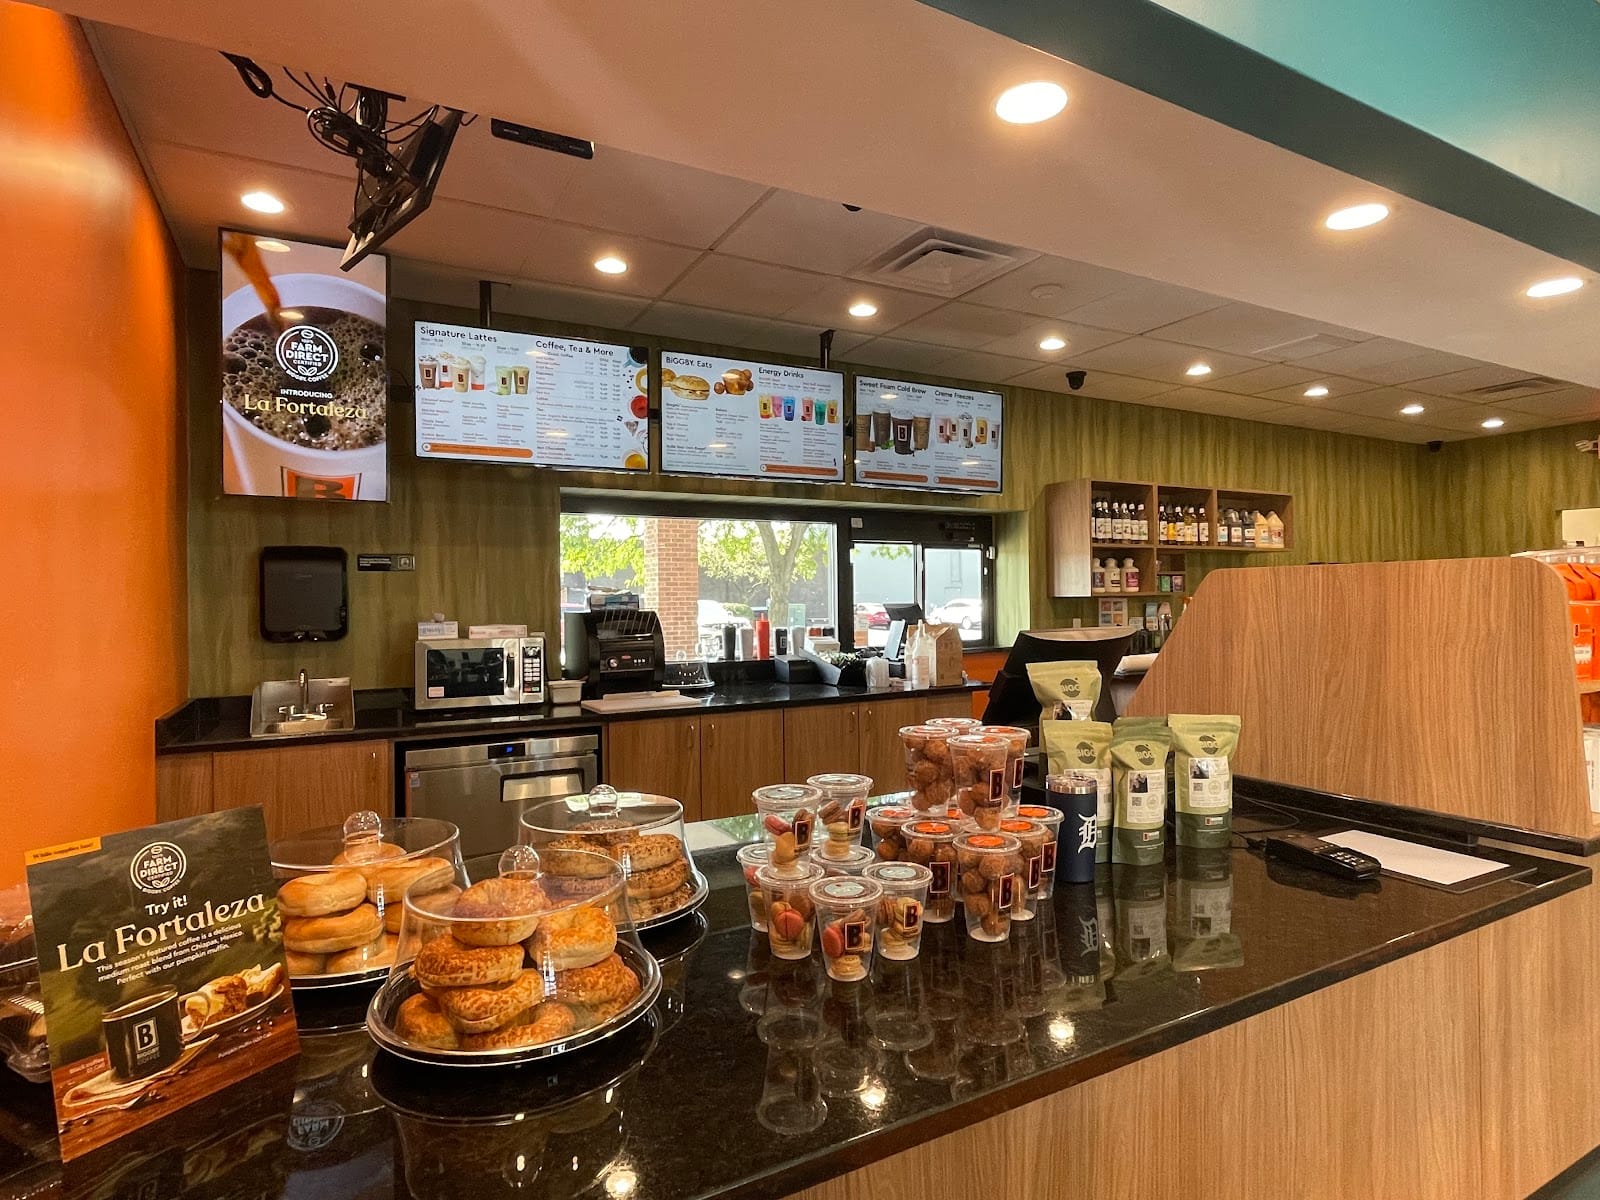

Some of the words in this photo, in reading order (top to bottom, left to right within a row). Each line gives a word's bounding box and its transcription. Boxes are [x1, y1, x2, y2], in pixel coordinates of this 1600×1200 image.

[420, 326, 466, 339] Signature
[468, 332, 497, 343] Lattes
[290, 341, 323, 353] FARM
[535, 340, 567, 352] Coffee,
[569, 344, 583, 353] Tea
[593, 348, 614, 356] More
[285, 350, 329, 362] DIRECT
[292, 359, 322, 367] CERTIFIED
[696, 360, 713, 369] Eats
[758, 367, 782, 377] Energy
[783, 369, 805, 379] Drinks
[280, 388, 333, 399] INTRODUCING
[859, 380, 879, 389] Sweet
[879, 383, 896, 391] Foam
[897, 385, 911, 393] Cold
[911, 387, 927, 395] Brew
[934, 390, 953, 398] Creme
[954, 393, 975, 401] Freezes
[244, 393, 270, 411] La
[275, 396, 368, 419] Fortaleza
[139, 861, 178, 878] DIRECT
[143, 855, 172, 869] FARM
[144, 902, 170, 916] Try
[172, 895, 188, 909] it!
[56, 940, 107, 972] La
[115, 893, 265, 955] Fortaleza
[96, 963, 113, 974] This
[114, 952, 146, 968] season's
[147, 943, 177, 958] featured
[178, 936, 201, 950] coffee
[213, 923, 242, 936] delicious
[98, 967, 130, 983] medium
[130, 961, 151, 973] roast
[151, 953, 173, 966] blend
[173, 948, 190, 960] from
[116, 972, 144, 986] Perfect
[145, 965, 162, 976] with
[162, 961, 175, 970] our
[175, 951, 206, 967] pumpkin
[206, 943, 230, 955] muffin.
[137, 1024, 154, 1048] B
